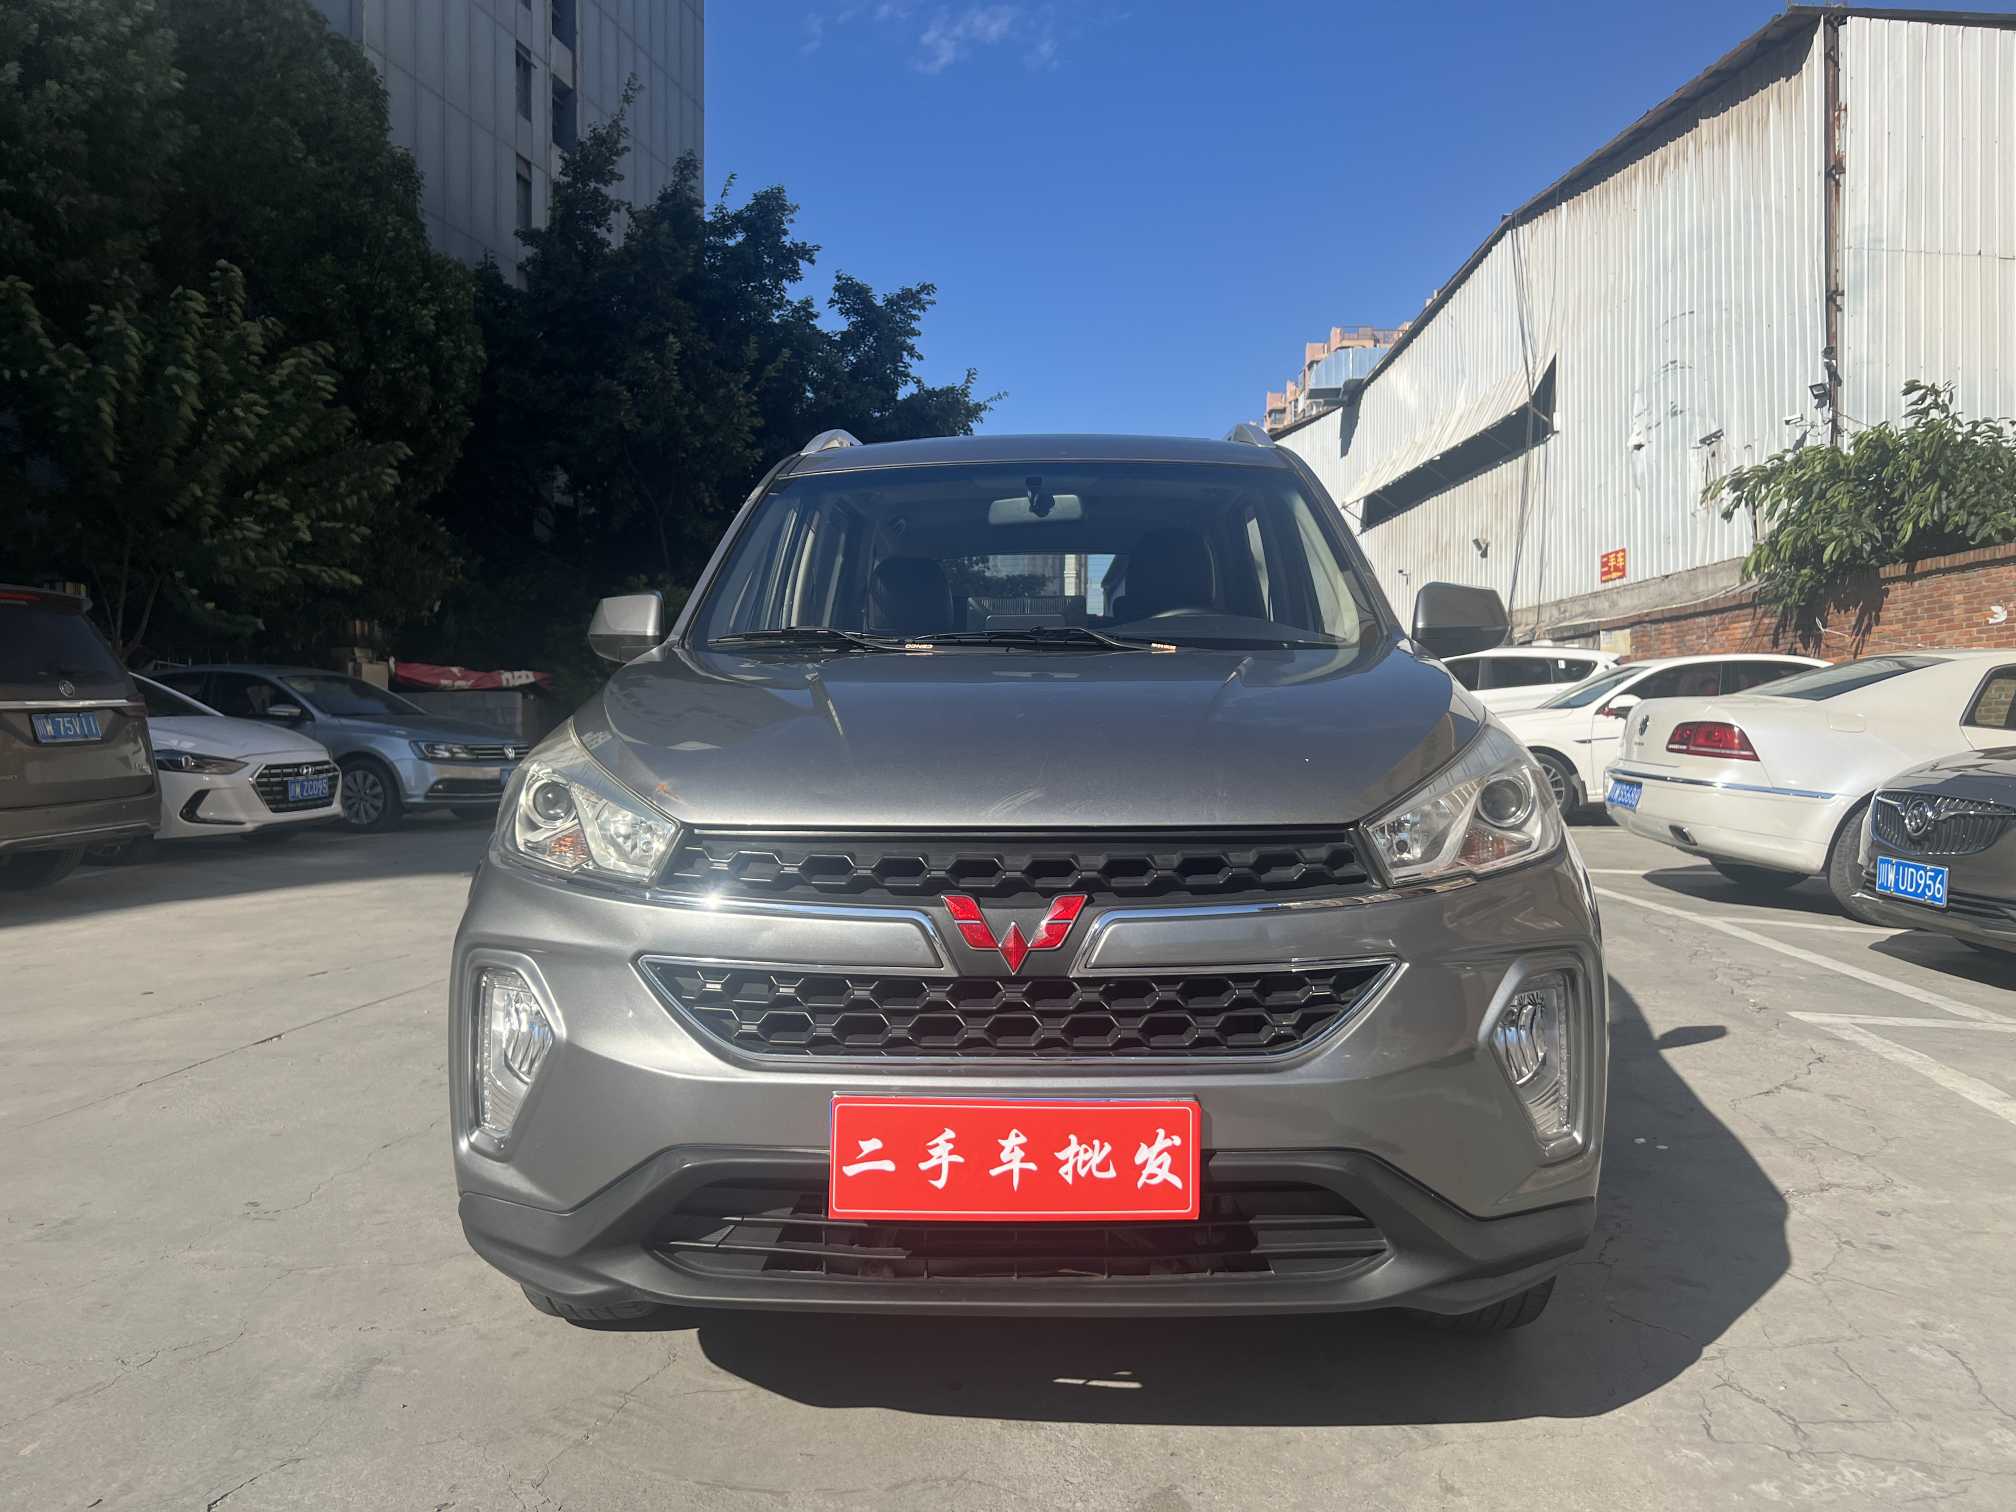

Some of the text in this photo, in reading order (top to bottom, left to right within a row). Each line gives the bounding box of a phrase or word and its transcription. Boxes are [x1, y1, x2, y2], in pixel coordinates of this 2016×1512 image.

[1601, 551, 1624, 572] 二手车
[842, 1128, 1183, 1191] 二手车批发
